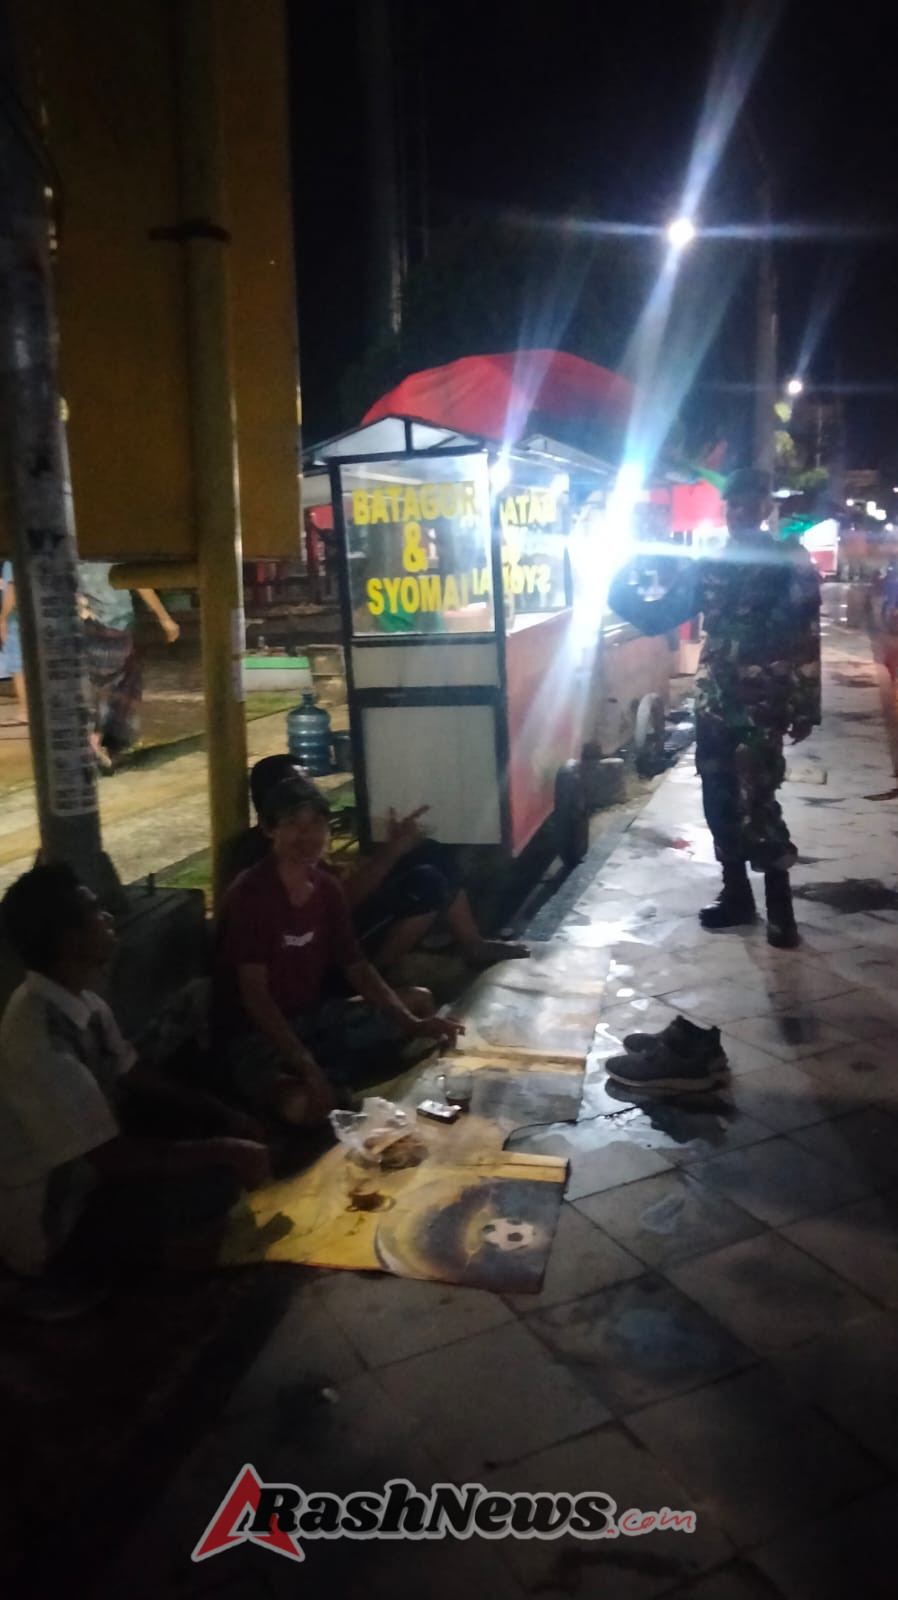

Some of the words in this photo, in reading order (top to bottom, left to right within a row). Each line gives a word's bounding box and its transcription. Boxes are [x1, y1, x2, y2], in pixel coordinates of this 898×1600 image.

[351, 481, 481, 525] BATAGOR
[403, 522, 427, 572] &
[367, 574, 469, 615] SYOMAI
